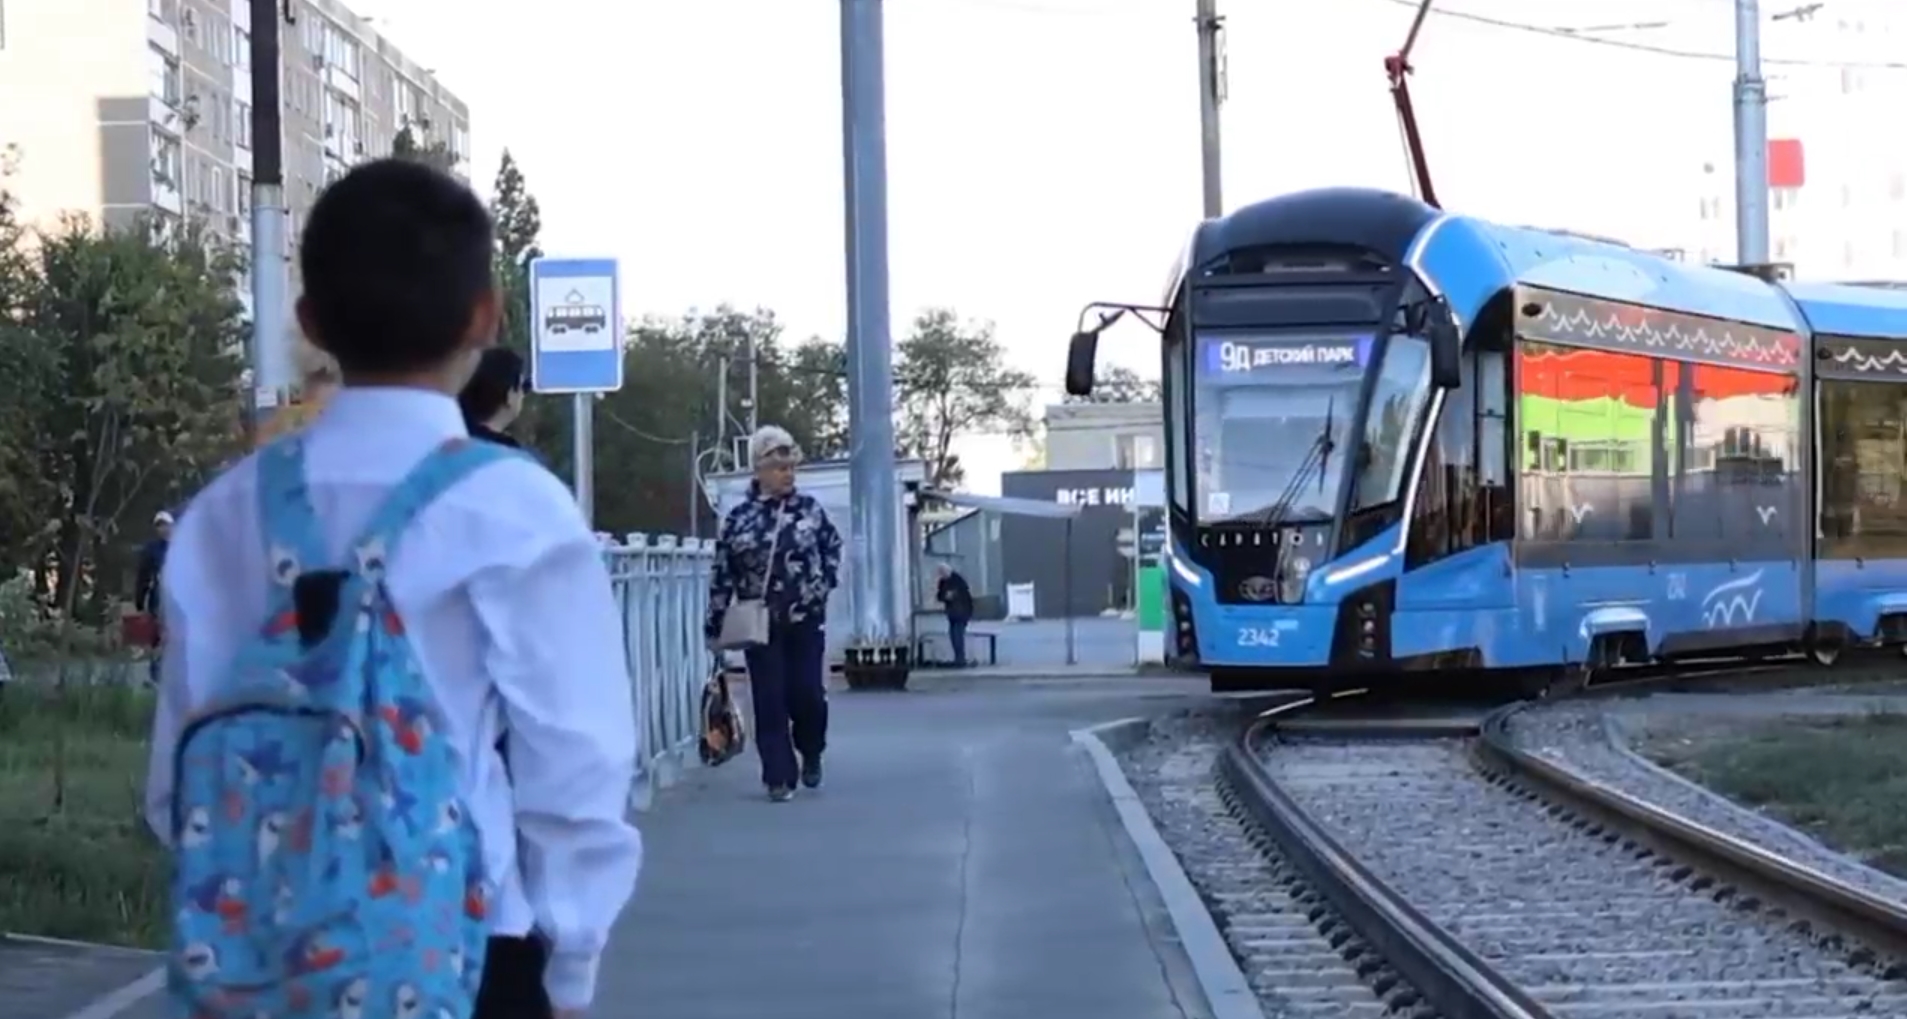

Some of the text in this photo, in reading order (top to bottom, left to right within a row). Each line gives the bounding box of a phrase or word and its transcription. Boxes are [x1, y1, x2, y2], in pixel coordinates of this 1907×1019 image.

[1220, 341, 1354, 371] 9Д ДЕТСКИЙ ПАРК
[1057, 488, 1100, 505] ВСЕ
[1237, 628, 1280, 647] 2342
